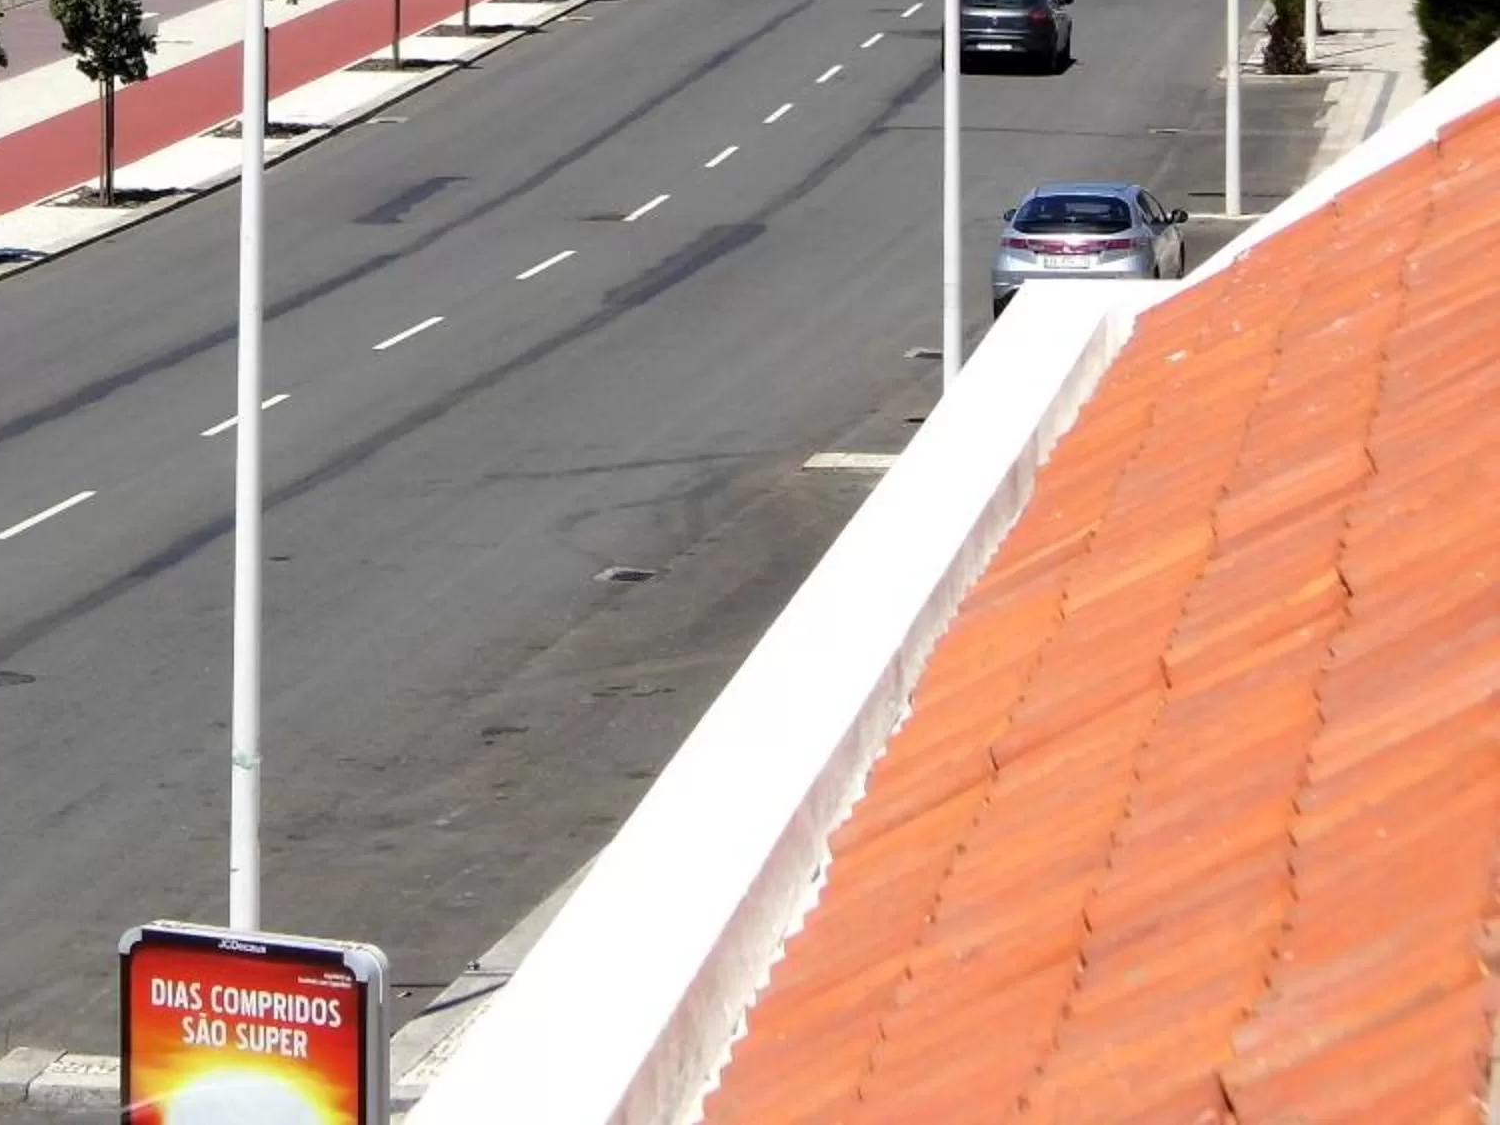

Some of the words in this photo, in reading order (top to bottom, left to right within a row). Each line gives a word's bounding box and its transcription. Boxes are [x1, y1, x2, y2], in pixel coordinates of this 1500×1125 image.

[151, 978, 203, 1011] DIAS
[211, 985, 342, 1028] COMPRIDOS
[181, 1012, 227, 1048] SÃO
[236, 1022, 309, 1059] SUPER
